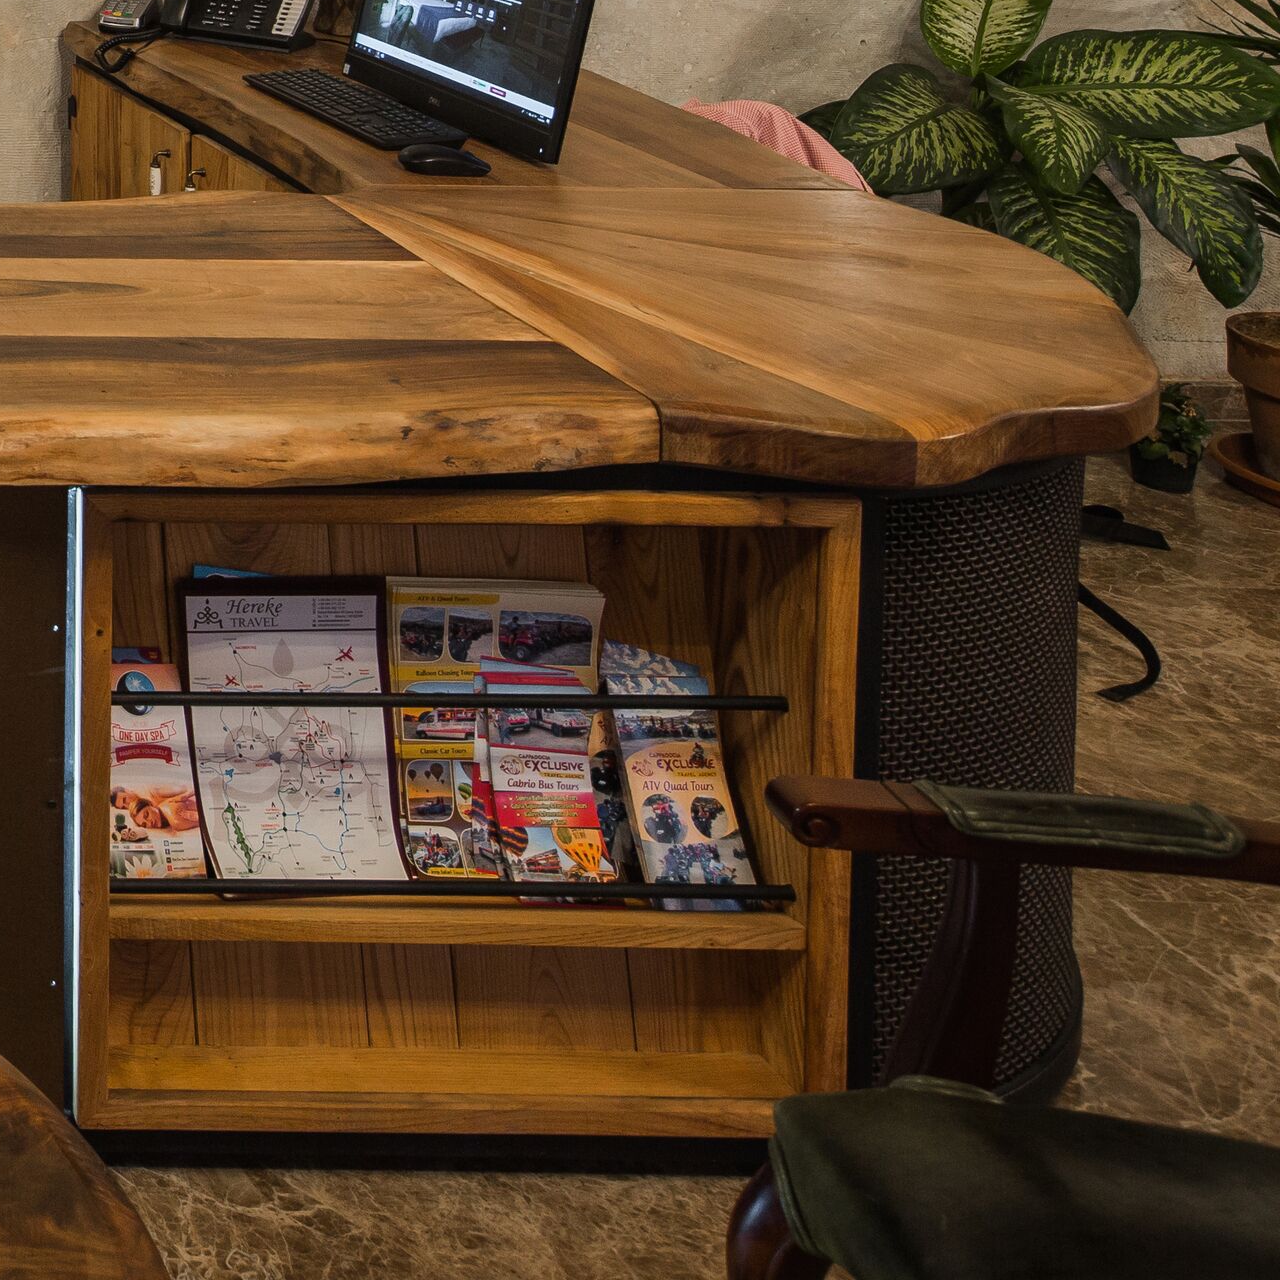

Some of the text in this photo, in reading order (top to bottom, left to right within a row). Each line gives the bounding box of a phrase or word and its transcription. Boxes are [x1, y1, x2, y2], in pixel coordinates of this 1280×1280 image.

[226, 598, 283, 617] Hereke
[231, 617, 278, 628] TRAVEL
[119, 730, 164, 742] ONE DAY SPA
[141, 748, 168, 756] YOURSELF
[525, 760, 584, 772] EXCLUSIVE
[508, 778, 579, 791] Cabrio Bus Tours
[643, 781, 714, 793] ATV Quad Tours
